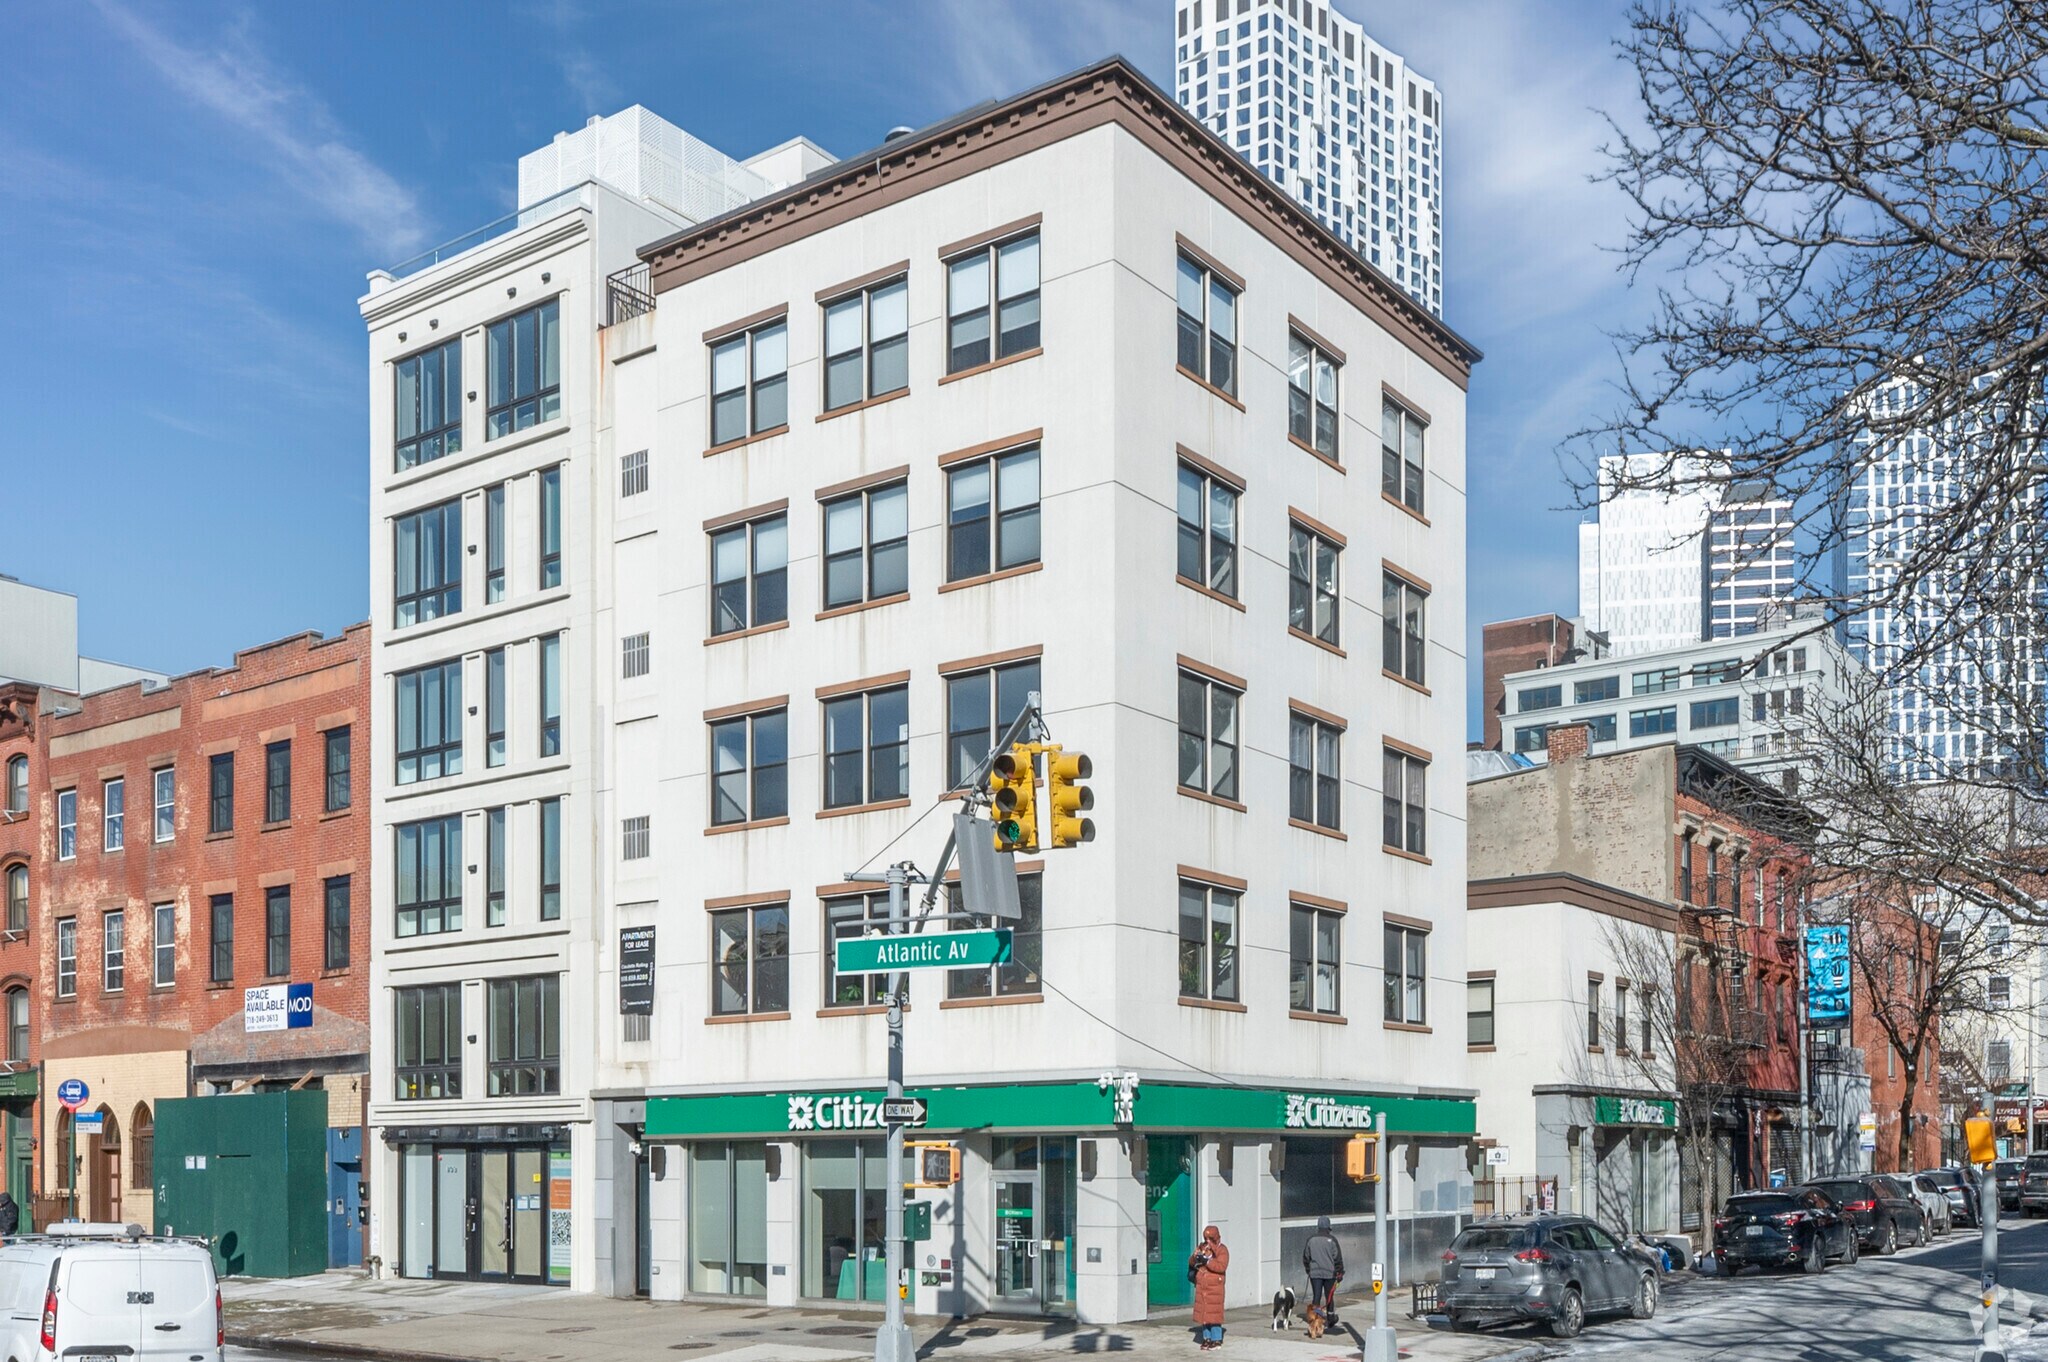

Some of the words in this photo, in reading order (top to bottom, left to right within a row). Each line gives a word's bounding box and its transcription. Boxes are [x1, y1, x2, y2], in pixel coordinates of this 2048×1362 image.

[621, 931, 655, 941] APARTMENTS
[625, 941, 635, 950] FOR
[636, 940, 650, 949] LEASE
[877, 940, 942, 963] Atlantic
[948, 941, 969, 960] Av
[246, 989, 270, 1002] SPACE
[246, 1000, 285, 1013] AVAILABLE
[288, 996, 312, 1014] MOD
[887, 1103, 898, 1115] ONE
[900, 1103, 914, 1115] WAY
[1305, 1097, 1372, 1128] Citizens
